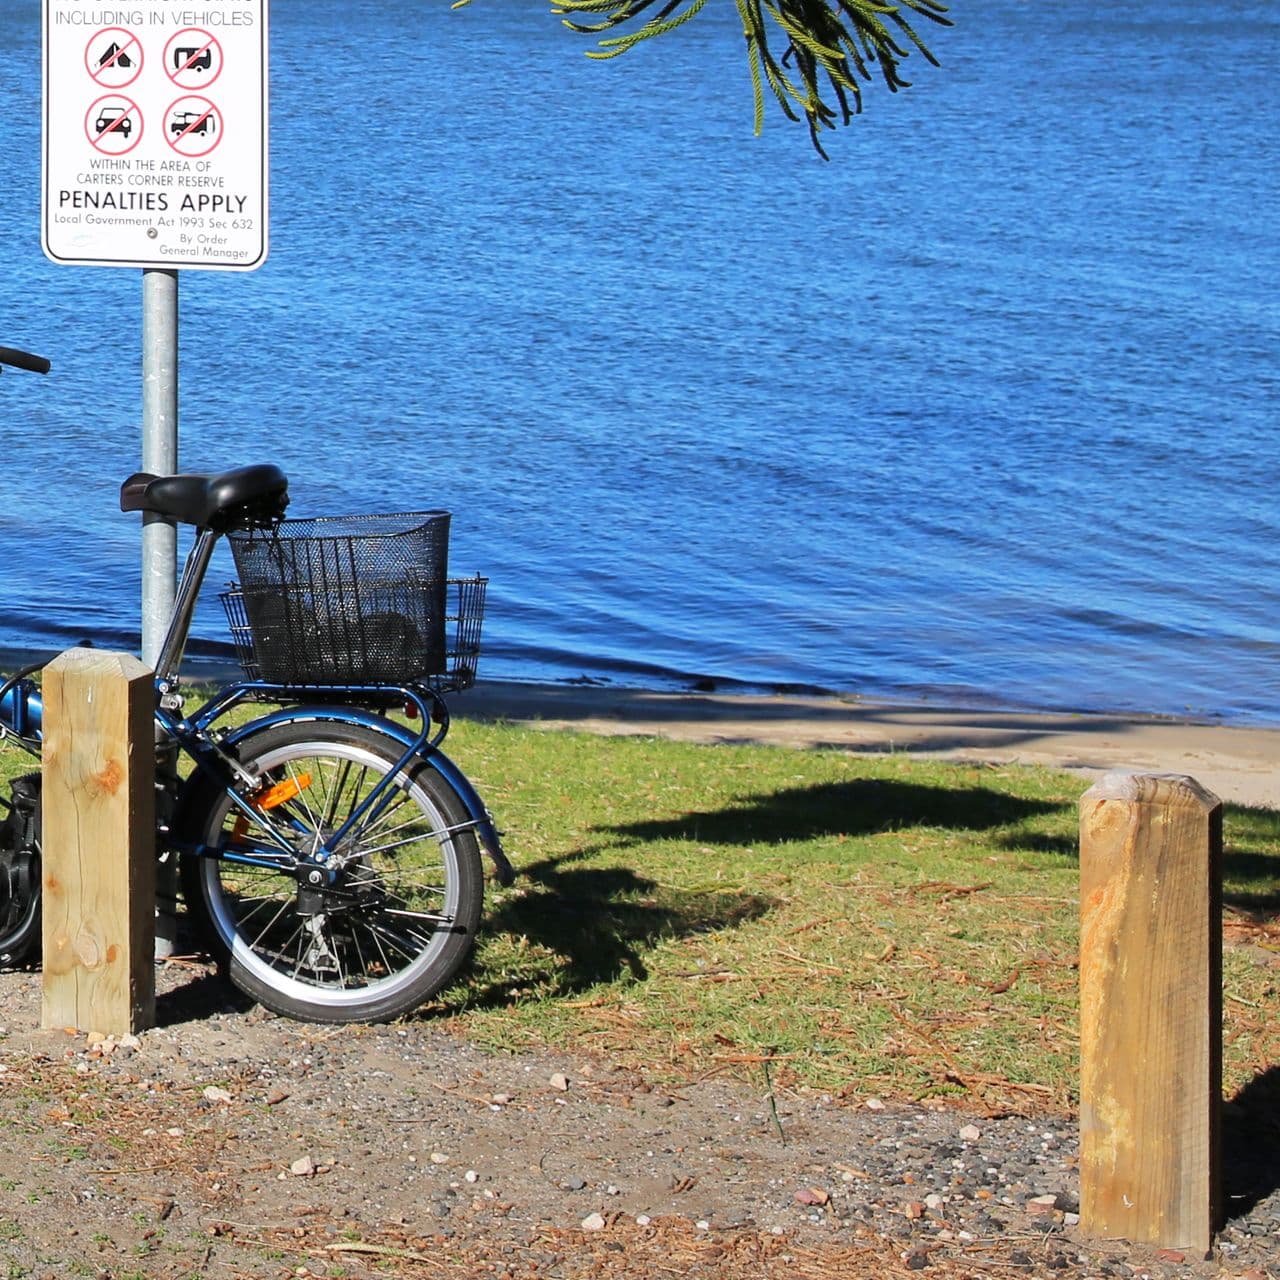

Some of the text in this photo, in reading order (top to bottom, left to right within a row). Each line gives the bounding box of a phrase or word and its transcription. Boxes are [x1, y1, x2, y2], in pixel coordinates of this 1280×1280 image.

[55, 11, 254, 26] INCLUDING IN VEHICLES
[89, 159, 212, 172] WITHIN THE AREA OF
[76, 173, 225, 188] CARTERS CORNER RESERVE
[60, 190, 248, 213] PENALTIES APPLY
[54, 213, 253, 230] Local Government Act 1993 Sec 632
[180, 233, 228, 245] By Order
[159, 244, 249, 260] General Manager
